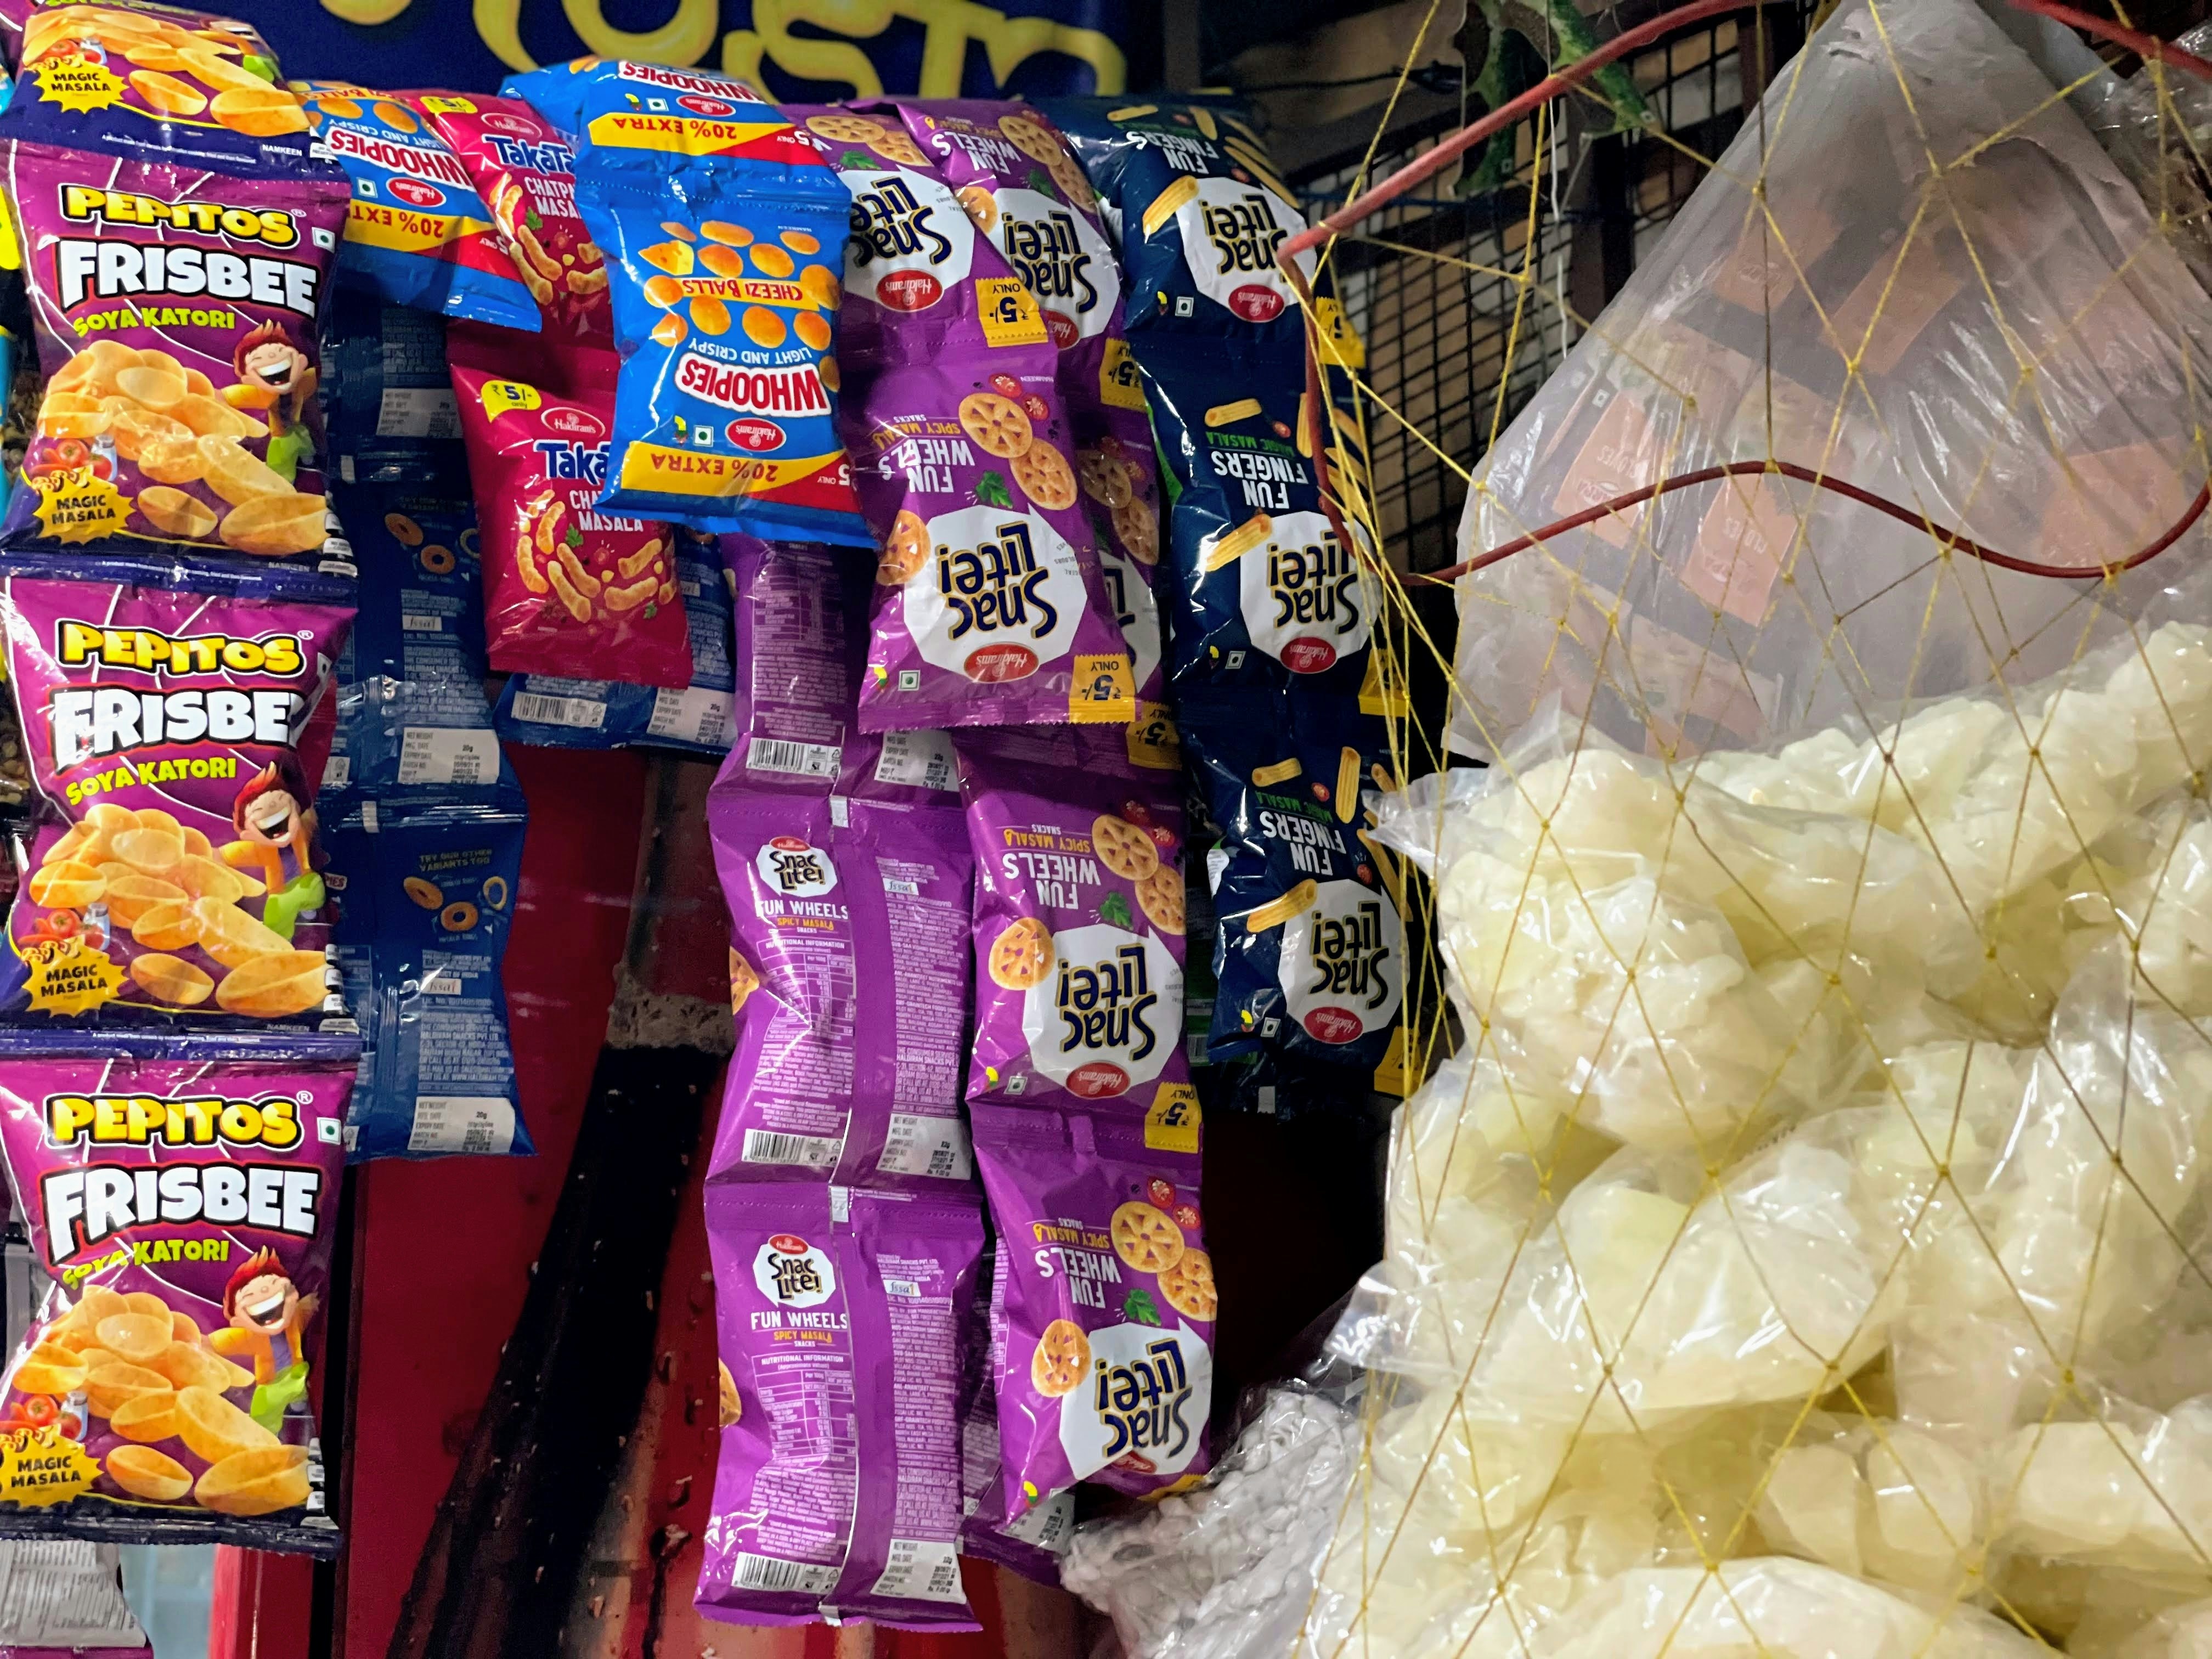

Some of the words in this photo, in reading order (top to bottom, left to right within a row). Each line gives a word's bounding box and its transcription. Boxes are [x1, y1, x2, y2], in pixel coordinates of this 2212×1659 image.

[52, 83, 111, 92] MASALA
[54, 72, 100, 81] MAGIC
[623, 63, 763, 101] WHOOPIES
[329, 119, 378, 136] CRISPY
[382, 129, 409, 143] AND
[612, 117, 684, 134] EXTRA
[690, 120, 737, 139] 20%
[262, 144, 303, 156] NAMKEEN
[932, 131, 1022, 170] WHEELS
[1126, 131, 1220, 160] FINGERS
[330, 129, 472, 187] WHOOPIES
[967, 150, 1011, 176] FUN
[1163, 146, 1209, 174] FUN
[62, 185, 297, 246] PEPITOS
[534, 196, 582, 219] MASA
[398, 211, 444, 238] 20%
[849, 206, 952, 267] Snac
[60, 240, 317, 318] FRISBEE
[682, 279, 741, 298] BALLS
[992, 283, 1020, 295] ONLY
[1013, 255, 1098, 314] Snac
[745, 283, 803, 301] CHEEZI
[74, 308, 133, 337] SOYA
[142, 307, 235, 329] KATORI
[689, 337, 737, 361] CRISPY
[741, 351, 769, 364] AND
[775, 347, 812, 364] LIGHT
[681, 359, 827, 411] WHOOPIES
[893, 414, 927, 424] SNACKS
[926, 421, 961, 435] SPICY
[1206, 431, 1257, 449] MASALA
[651, 453, 724, 475] EXTRA
[731, 459, 778, 482] 20%
[878, 438, 975, 481] WHEELS
[1211, 450, 1308, 484] FINGERS
[817, 475, 836, 484] ONLY
[906, 465, 954, 493] FUN
[56, 495, 106, 510] MAGIC
[1242, 478, 1290, 509] FUN
[52, 509, 116, 524] MASALA
[578, 511, 643, 532] MASALA
[945, 568, 1058, 641] Snac
[1273, 572, 1359, 635] Snac
[61, 622, 302, 675] PEPITOS
[1091, 661, 1119, 671] ONLY
[66, 767, 134, 805] SOYA
[137, 758, 236, 785] KATORI
[1255, 790, 1302, 810] MASALA
[1003, 828, 1054, 850] MASALA
[1031, 823, 1061, 835] SNACKS
[1259, 810, 1346, 854] FINGERS
[1059, 836, 1091, 853] SPICY
[769, 851, 819, 872] Snac
[1002, 852, 1101, 885] WHEELS
[1289, 842, 1333, 876] FUN
[1036, 879, 1079, 910] FUN
[789, 900, 849, 919] WHEELS
[777, 917, 800, 927] SPICY
[803, 918, 834, 931] MASALA
[805, 940, 845, 949] INFORMATION
[46, 964, 98, 982] MAGIC
[1308, 947, 1390, 1010] Snac
[41, 977, 108, 997] MASALA
[1060, 994, 1157, 1062] Snac
[1170, 1089, 1194, 1099] ONLY
[52, 1097, 299, 1146] PEPITOS
[45, 1166, 318, 1261] FRISBEE
[1058, 1216, 1084, 1231] SNACKS
[1032, 1223, 1079, 1244] MASALA
[1081, 1231, 1109, 1250] SPICY
[62, 1250, 129, 1289] SOYA
[133, 1239, 229, 1265] KATORI
[768, 1253, 817, 1280] Snac
[1034, 1246, 1122, 1283] WHEELS
[1069, 1276, 1105, 1308] FUN
[751, 1311, 782, 1330] FUN
[786, 1311, 848, 1330] WHEELS
[774, 1331, 798, 1341] SPICY
[801, 1331, 833, 1343] MASALA
[761, 1355, 802, 1365] NUTRITIONAL
[803, 1355, 844, 1363] INFORMATION
[1102, 1387, 1193, 1459] Snac
[17, 1455, 72, 1472] MAGIC
[10, 1470, 82, 1488] MASALA
